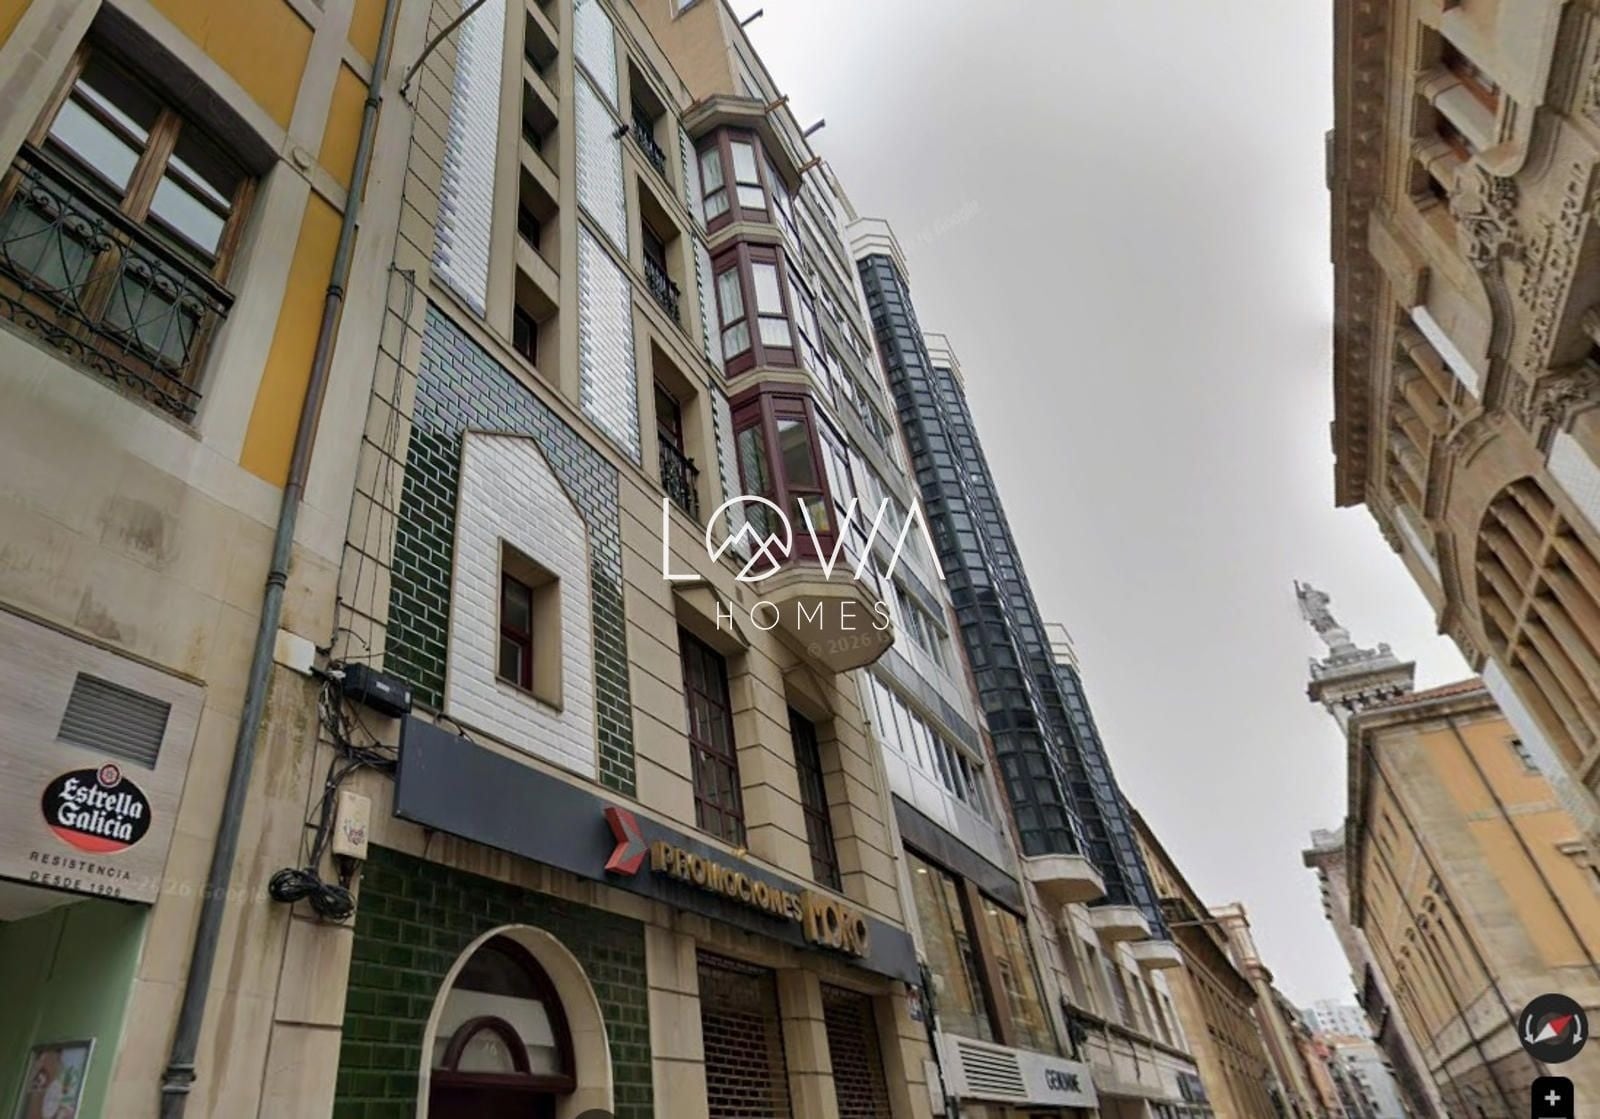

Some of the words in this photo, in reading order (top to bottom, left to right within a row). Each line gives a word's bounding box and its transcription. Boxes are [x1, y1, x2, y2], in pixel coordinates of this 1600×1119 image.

[59, 777, 143, 819] Estrella
[57, 801, 133, 840] Galicia
[29, 851, 131, 880] RESISTENCIA
[29, 870, 81, 890] DESDE
[651, 840, 804, 922] PROMOCIONES
[803, 890, 870, 957] MORO
